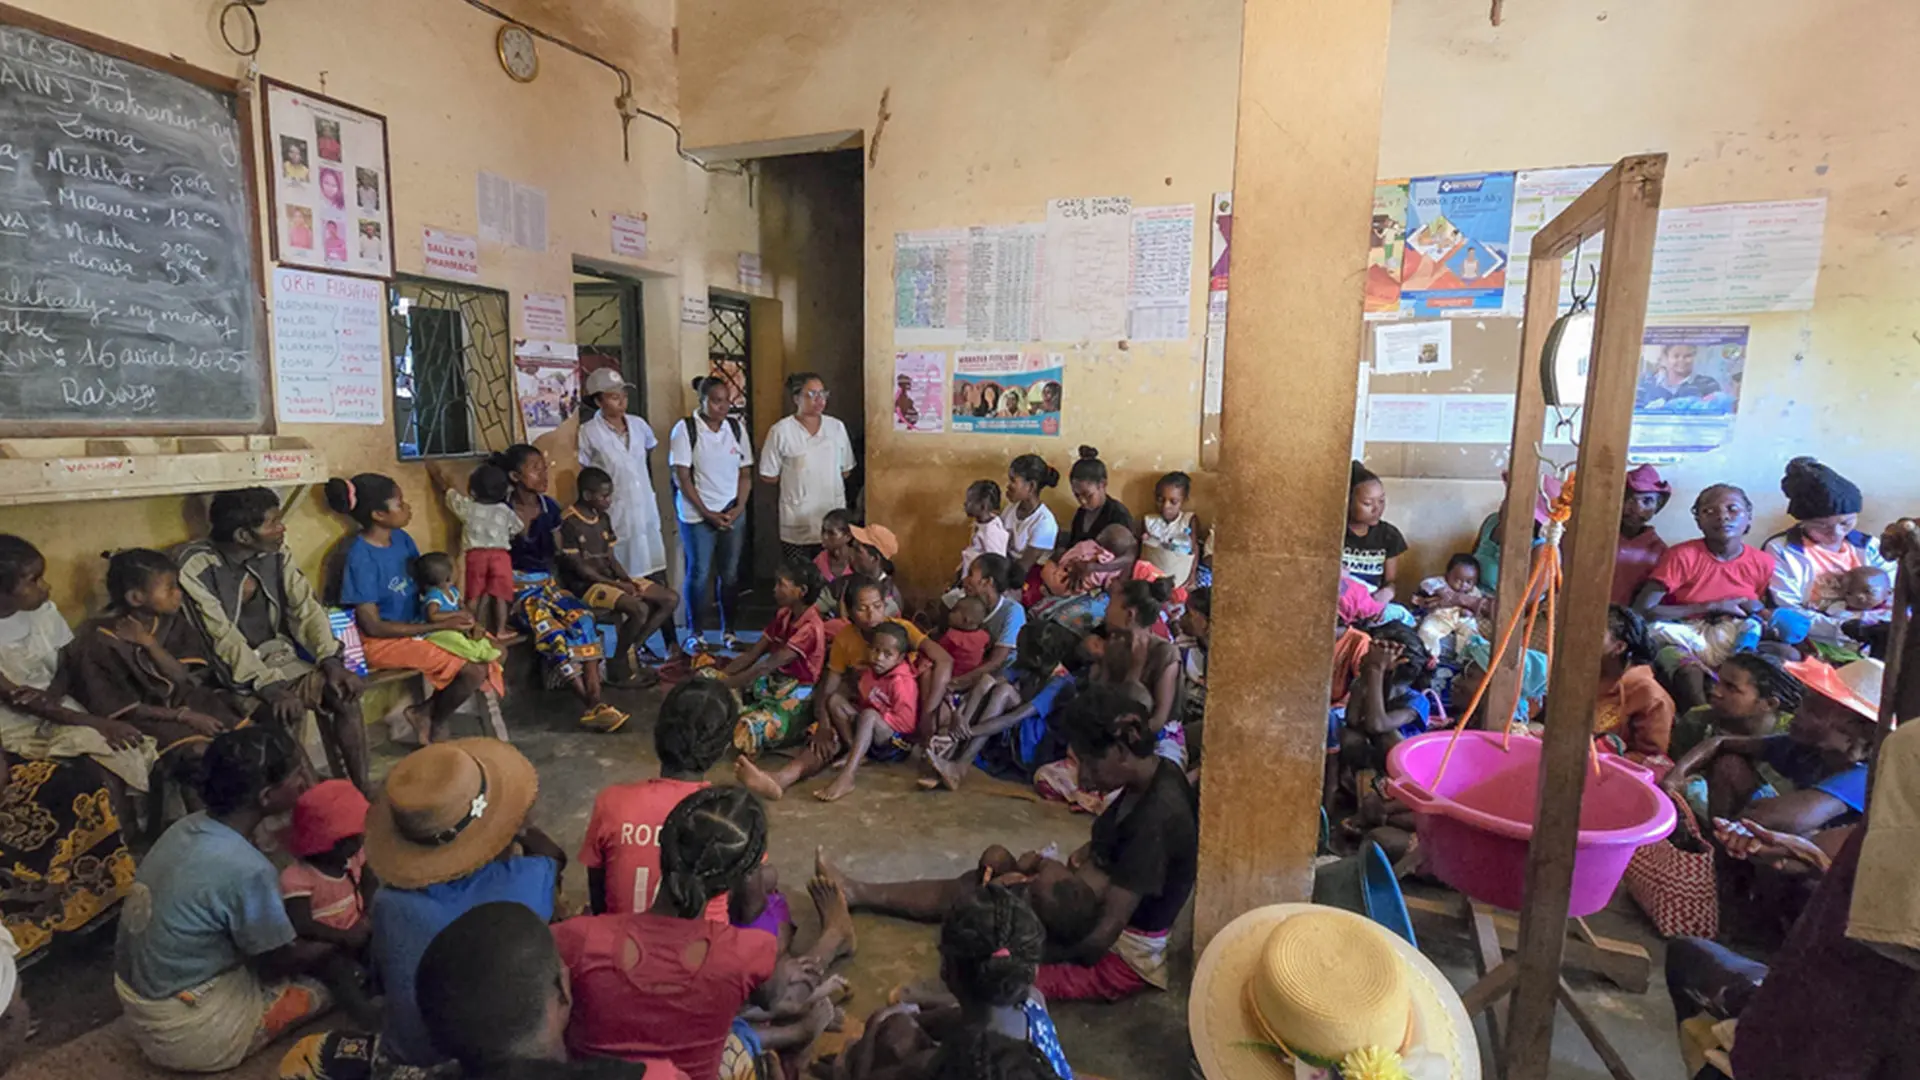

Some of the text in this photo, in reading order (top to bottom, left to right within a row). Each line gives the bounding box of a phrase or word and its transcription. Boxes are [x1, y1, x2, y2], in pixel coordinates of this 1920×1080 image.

[2, 30, 128, 82] FIASANA
[46, 105, 146, 154] Zoma
[427, 243, 455, 257] SALLE
[425, 256, 478, 275] PHARMACIE
[281, 274, 316, 293] ORA
[78, 337, 116, 369] 16
[119, 341, 179, 368] avril
[183, 345, 248, 374] 2025
